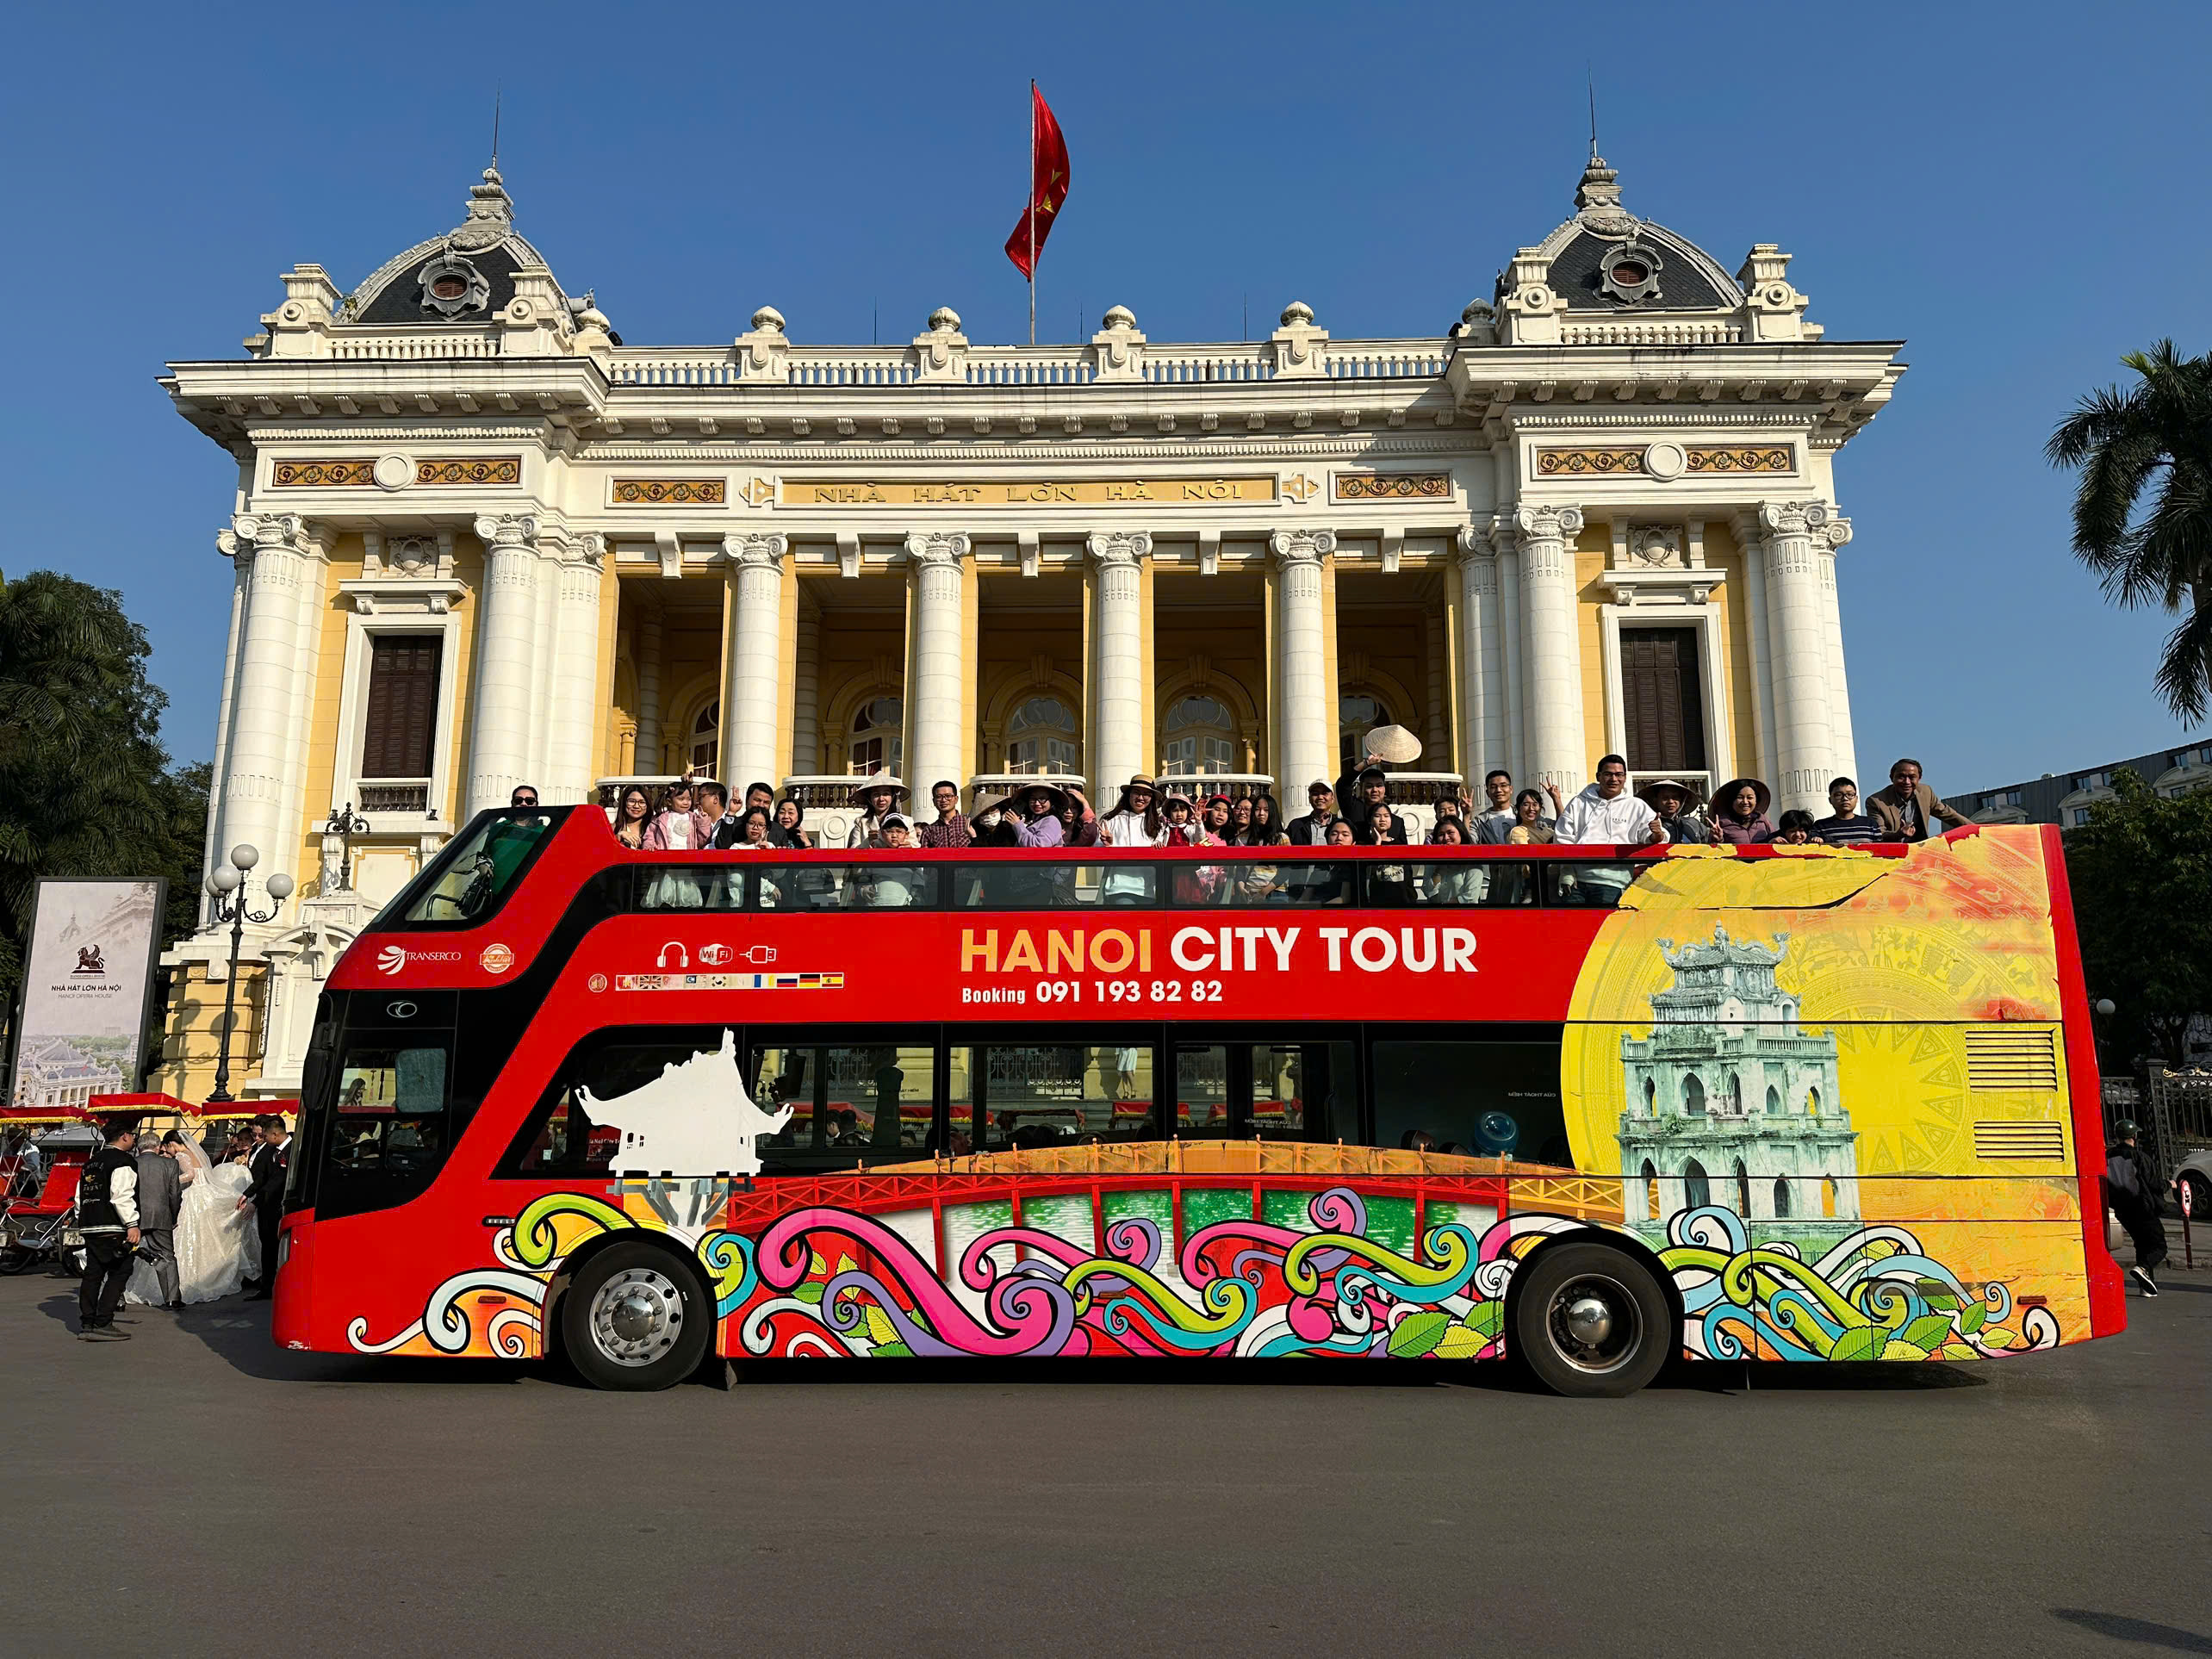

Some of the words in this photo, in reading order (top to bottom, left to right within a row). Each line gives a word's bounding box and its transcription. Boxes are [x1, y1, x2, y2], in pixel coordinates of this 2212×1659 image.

[814, 482, 886, 502] NHÀ
[913, 482, 981, 502] HÁT
[1106, 480, 1153, 500] HÀ
[406, 951, 462, 961] TRANSERCO
[960, 929, 1152, 973] HANOI
[1170, 926, 1300, 972] CITY
[1319, 926, 1478, 973] TOUR
[109, 984, 121, 992] NỘI
[962, 988, 1026, 1004] Booking
[1035, 981, 1081, 1003] 091
[1095, 981, 1141, 1003] 193
[1150, 981, 1182, 1003] 82
[1190, 981, 1223, 1003] 82
